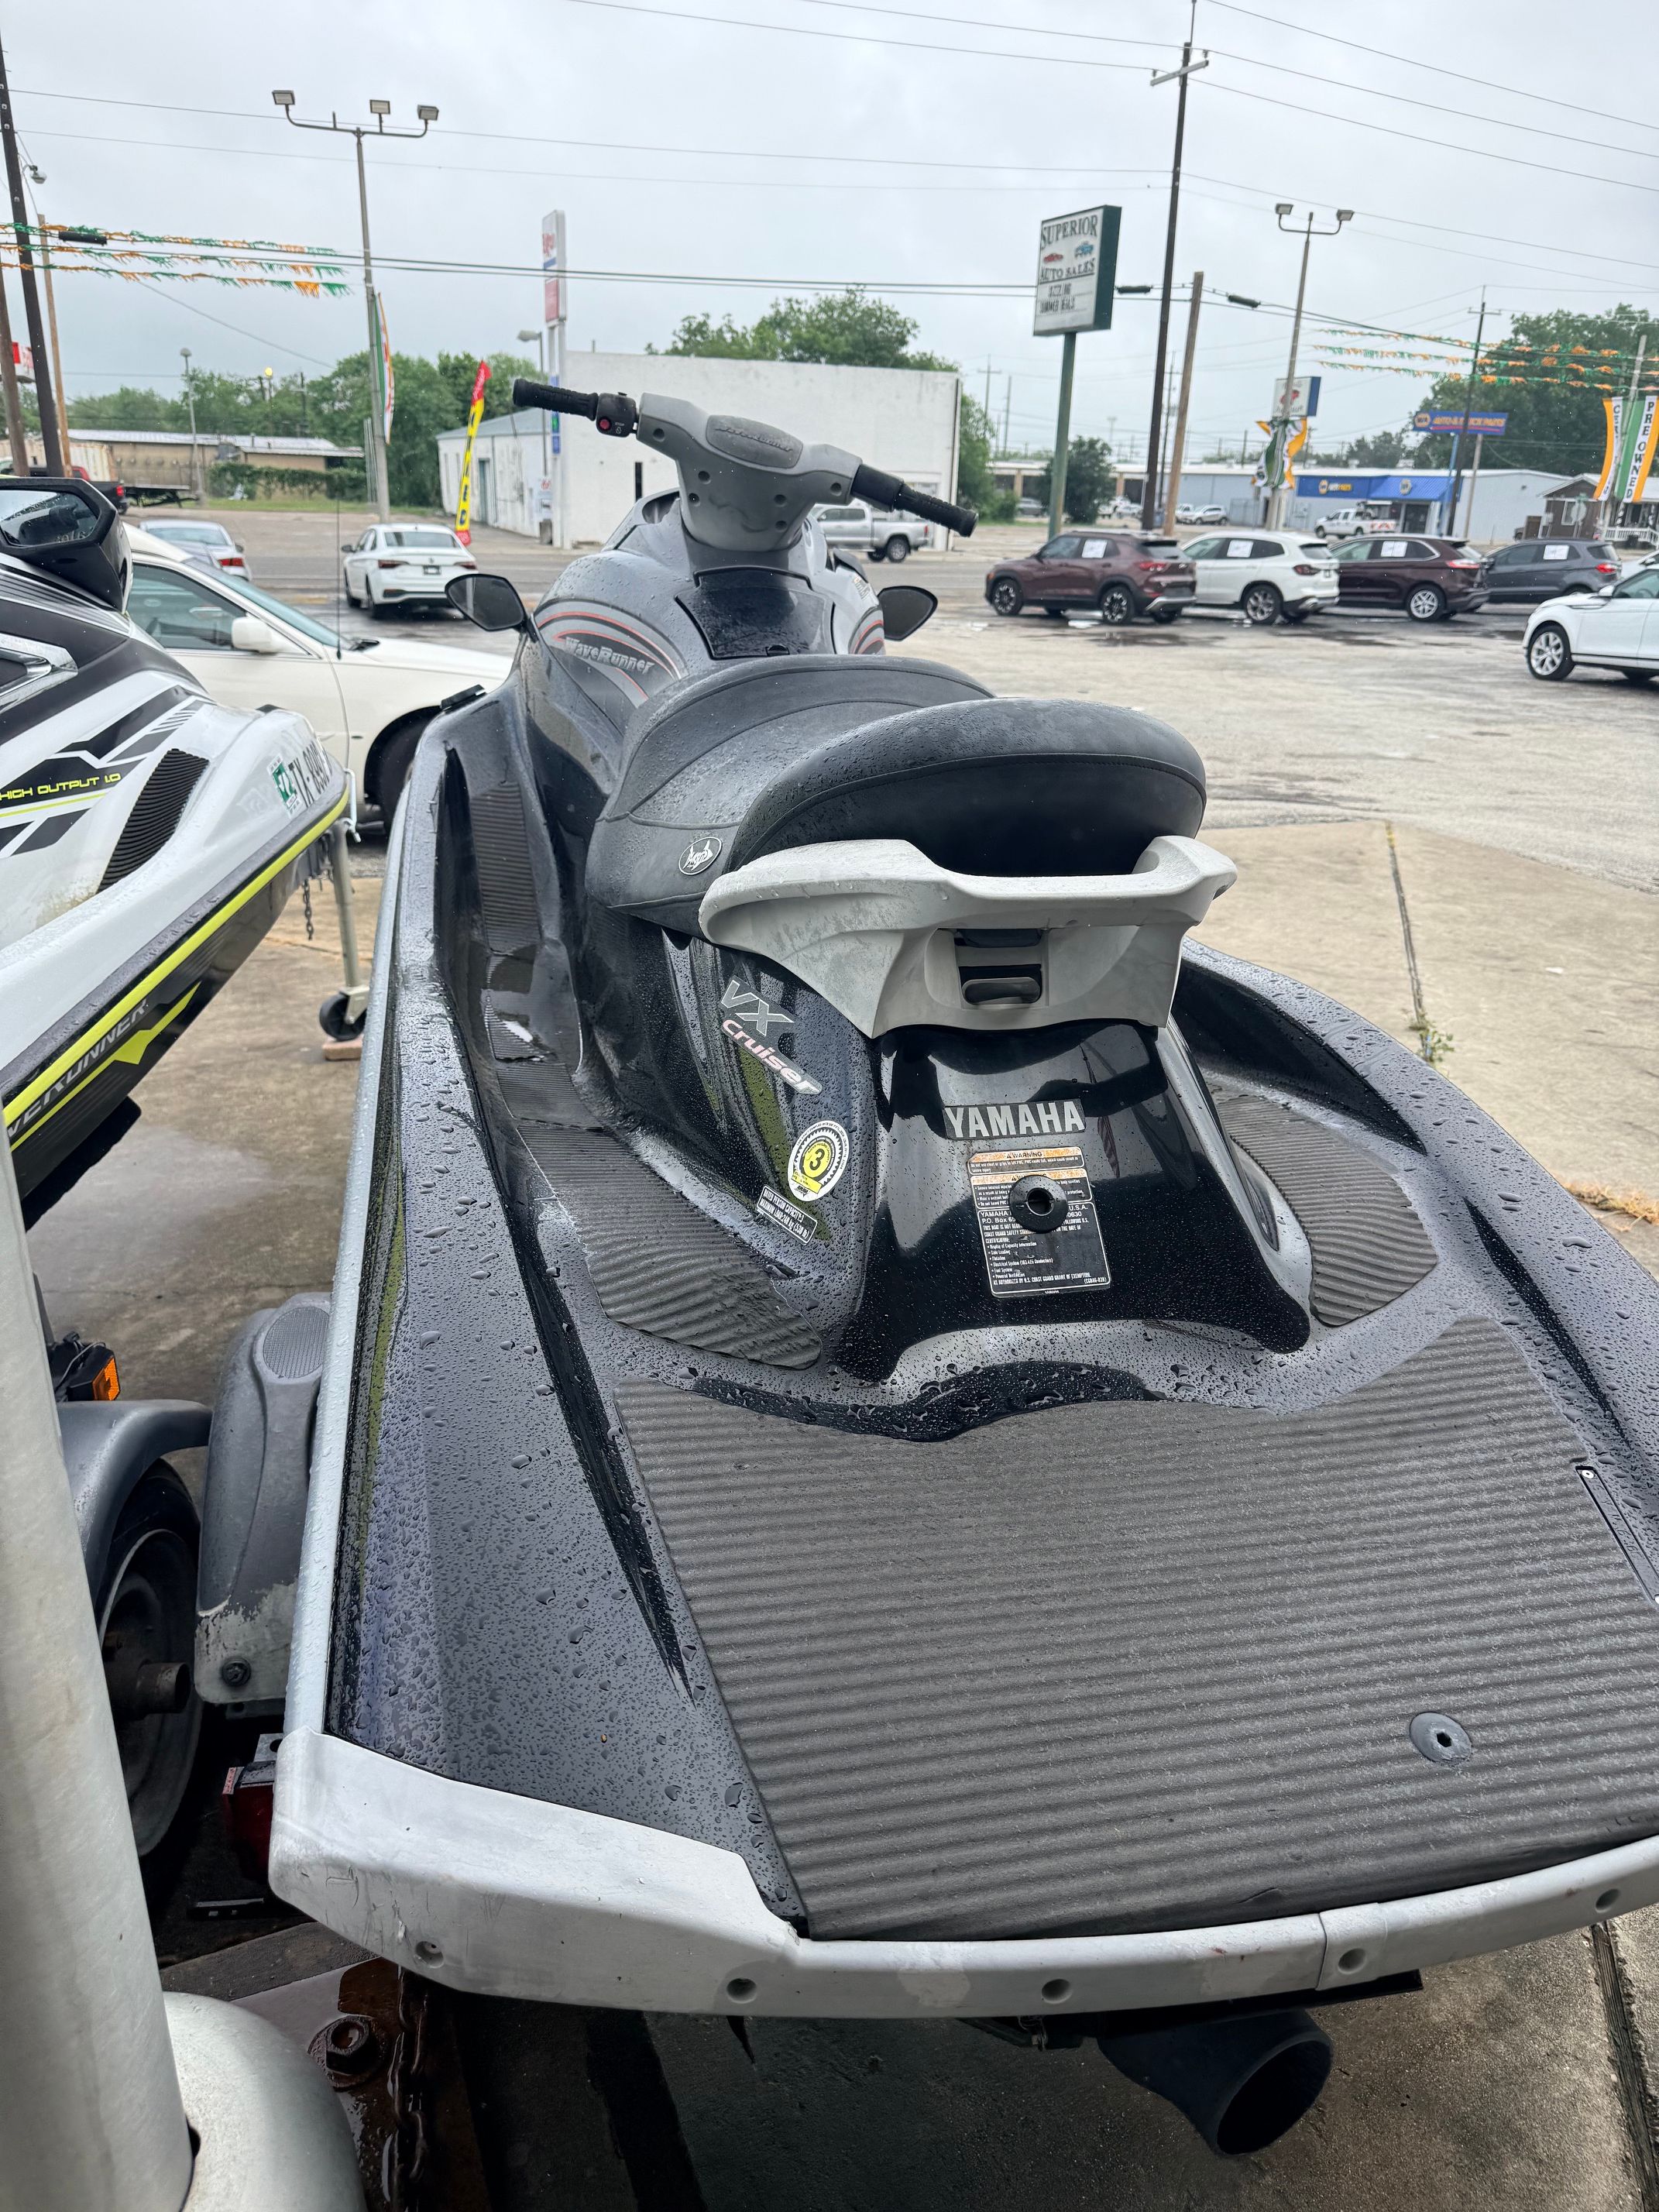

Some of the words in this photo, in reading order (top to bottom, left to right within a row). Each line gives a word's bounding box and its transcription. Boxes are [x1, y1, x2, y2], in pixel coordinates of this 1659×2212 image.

[1041, 215, 1097, 250] SUPERIOR
[565, 637, 655, 675] WaveRunner
[0, 787, 33, 802] HIGH
[37, 776, 100, 795] OUTPUT
[721, 980, 795, 1036] VX
[723, 1019, 820, 1093] Cruiser
[945, 1101, 1085, 1138] YAMAHA
[809, 1148, 825, 1171] 3
